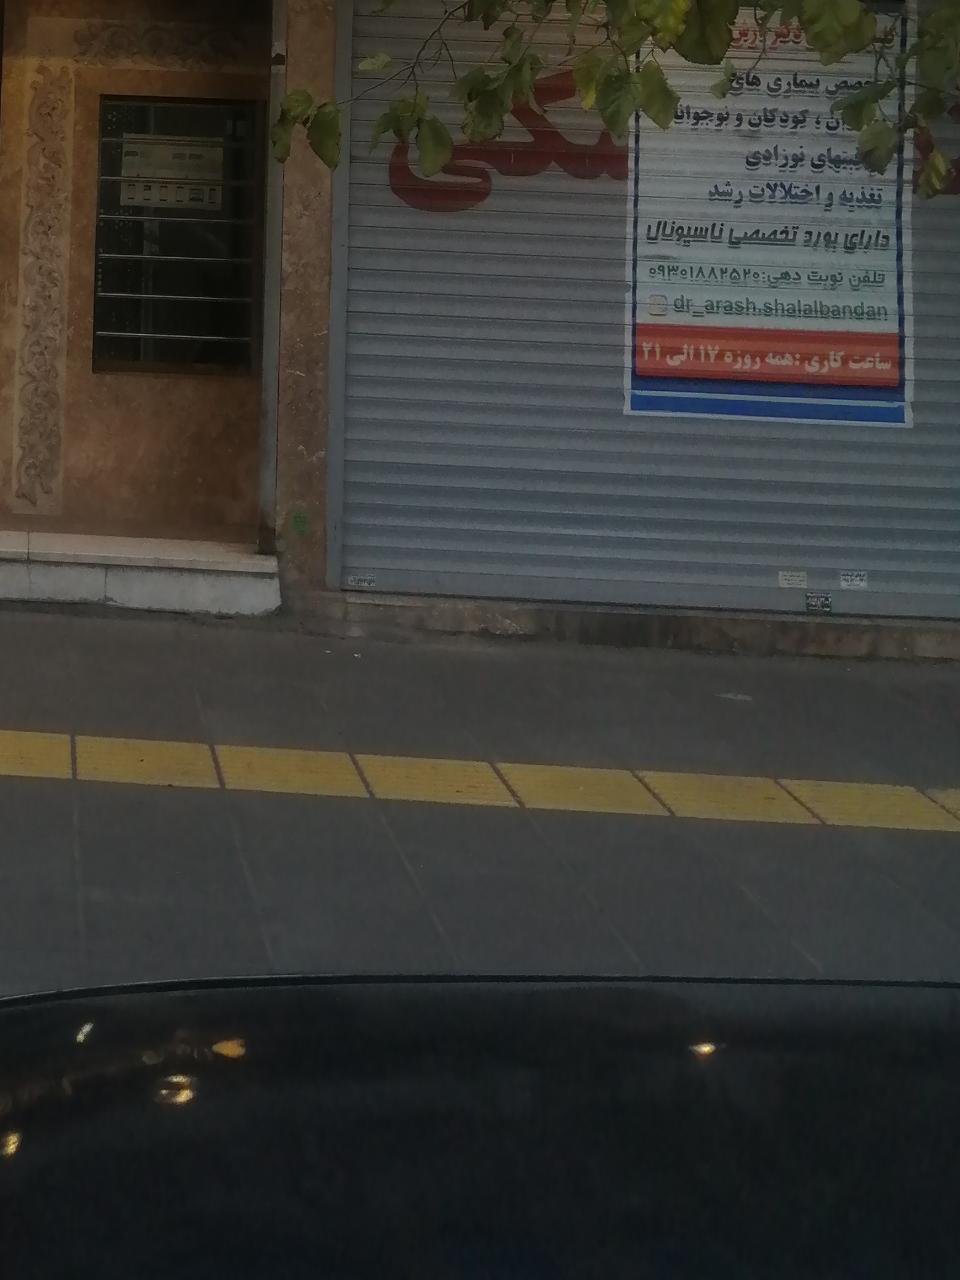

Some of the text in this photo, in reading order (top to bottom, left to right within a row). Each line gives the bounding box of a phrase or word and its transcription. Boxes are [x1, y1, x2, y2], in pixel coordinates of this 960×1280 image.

[767, 72, 820, 95] بیماری
[673, 104, 730, 129] نوجوانا
[734, 112, 743, 127] و
[748, 107, 809, 129] کودکان
[745, 145, 805, 169] نوزادی
[708, 181, 883, 208] تغذیه و اختلالات رشد
[646, 220, 891, 252] دارای بورد تخصصی ناسیونال
[807, 269, 844, 289] نوبت
[849, 271, 886, 290] تلفن
[673, 294, 888, 321] dr_arash.shalalbandan
[666, 343, 694, 367] الی
[724, 349, 761, 370] روزه
[804, 349, 844, 373] کاری
[849, 351, 892, 370] ساعت
